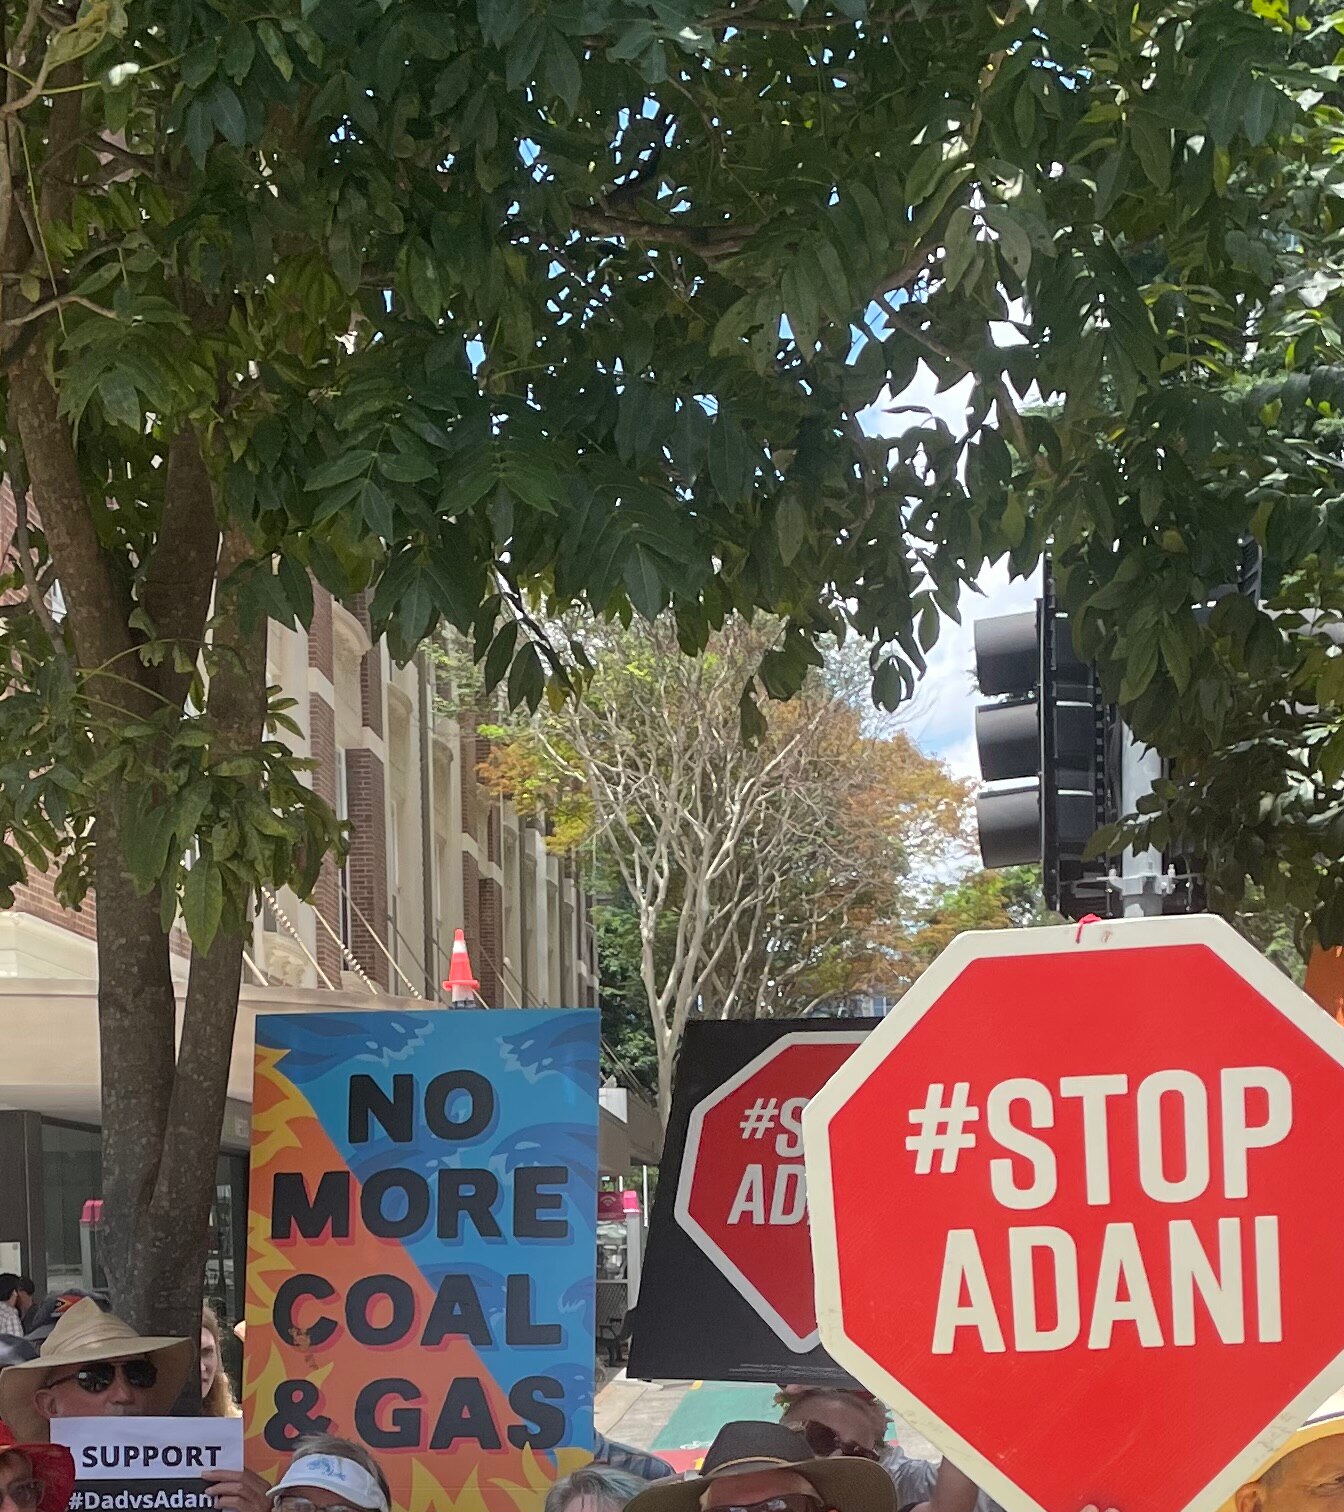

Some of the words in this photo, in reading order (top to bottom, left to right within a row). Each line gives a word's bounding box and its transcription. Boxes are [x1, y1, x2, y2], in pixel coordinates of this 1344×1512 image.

[348, 1069, 494, 1144] NO
[906, 1066, 1293, 1210] #STOP
[271, 1166, 569, 1240] MORE
[272, 1273, 562, 1348] COAL
[931, 1215, 1282, 1355] ADANI
[264, 1379, 330, 1451] &
[354, 1376, 565, 1451] GAS
[82, 1445, 222, 1468] SUPPORT
